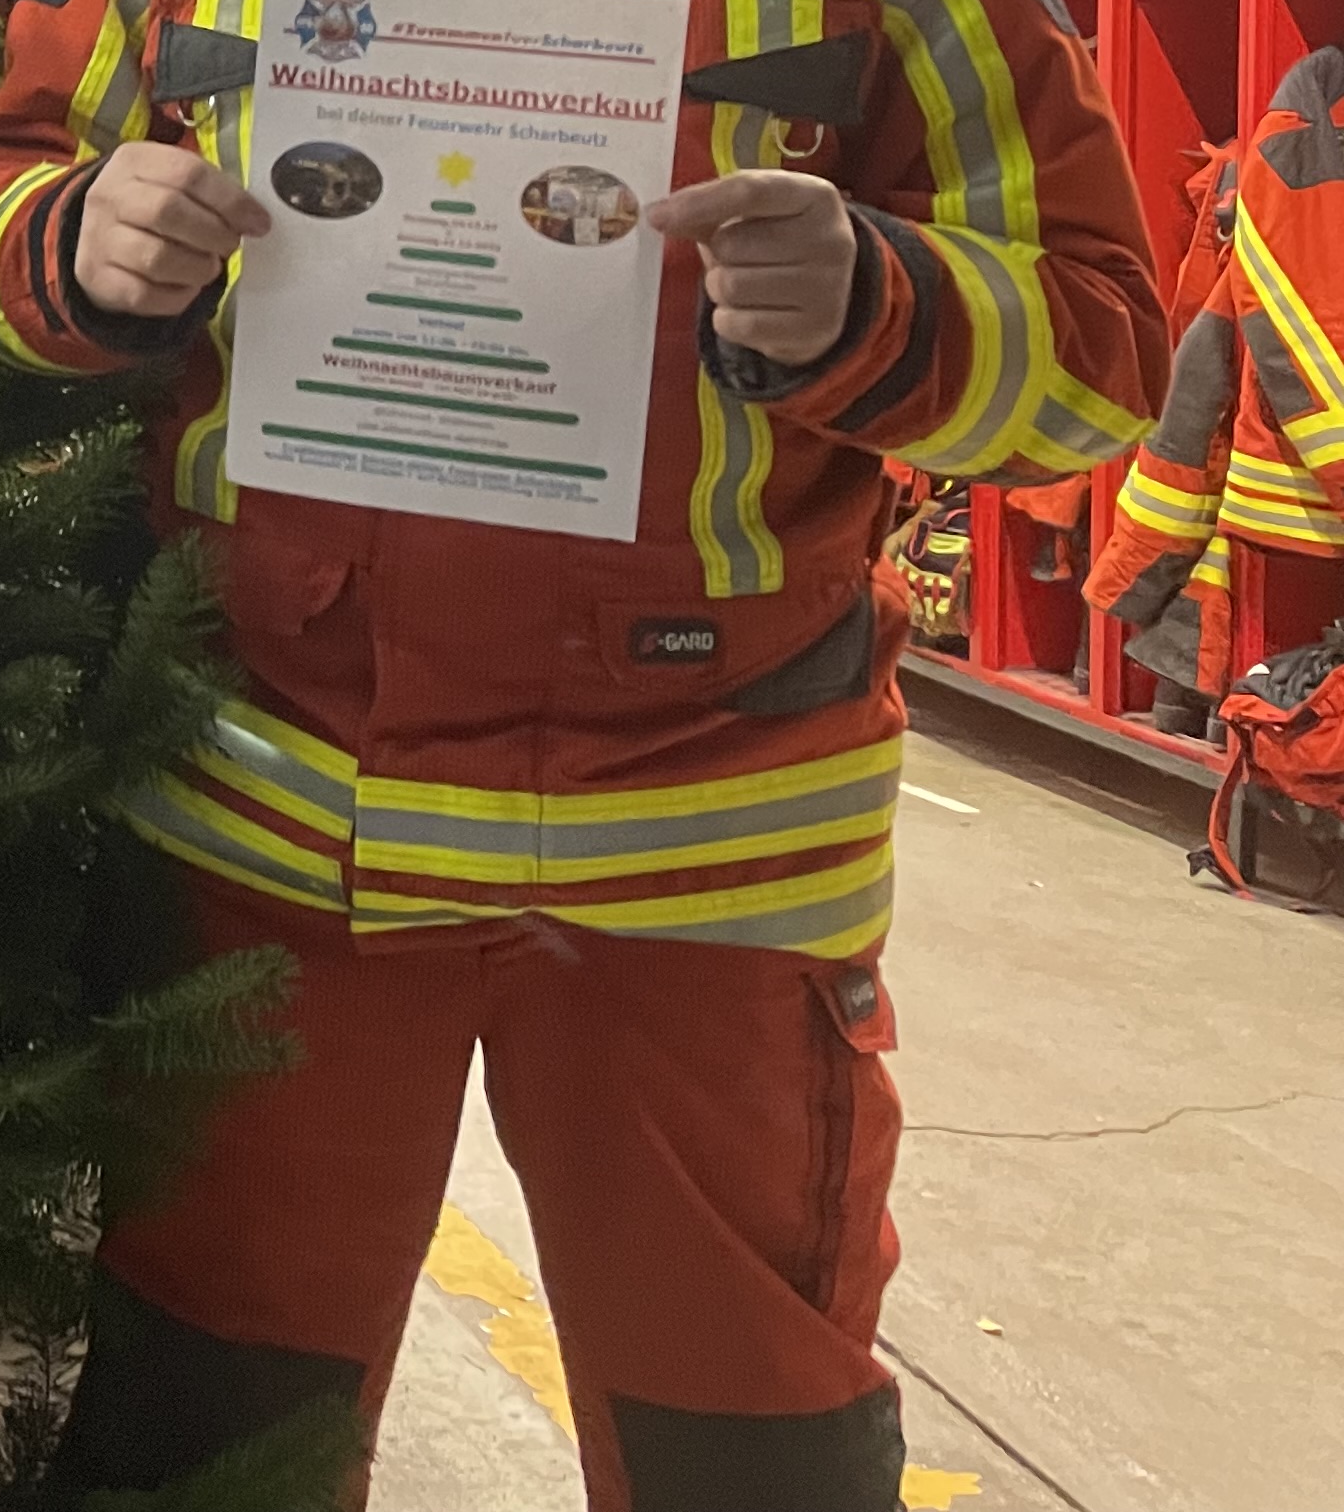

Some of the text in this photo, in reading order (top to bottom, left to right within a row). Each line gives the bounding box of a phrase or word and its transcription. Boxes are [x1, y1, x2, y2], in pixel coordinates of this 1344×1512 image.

[270, 62, 668, 121] Weihnachtsbaumverkauf
[409, 115, 502, 136] Feuerwehr
[509, 125, 608, 148] Scharbeutz
[322, 352, 557, 395] Weihnachtsbaumverkauf
